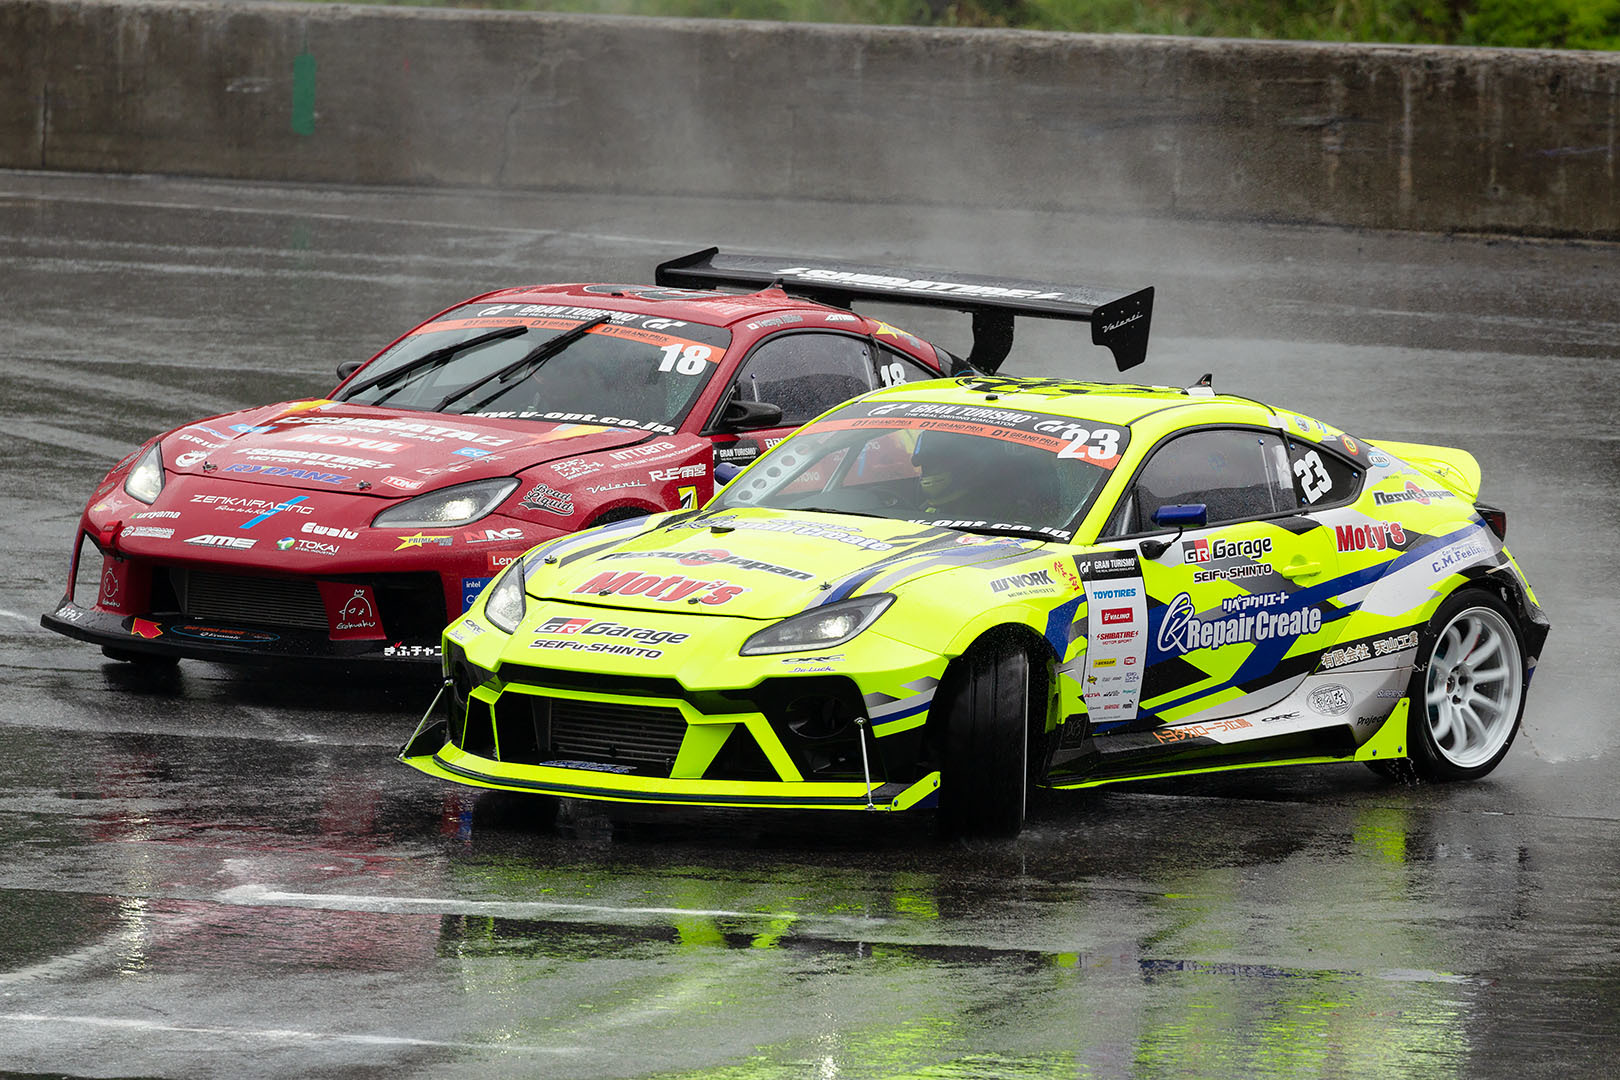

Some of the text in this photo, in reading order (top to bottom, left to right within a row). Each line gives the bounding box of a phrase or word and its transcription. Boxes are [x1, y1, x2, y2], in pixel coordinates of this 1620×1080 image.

[520, 304, 637, 322] GRAN TURISMO
[530, 319, 548, 327] D1
[1102, 312, 1143, 333] Valenti
[601, 326, 670, 342] D1 GRAND PRIX
[657, 343, 712, 376] 18
[880, 362, 907, 388] 18
[910, 404, 1031, 424] GRAN TURISMO
[940, 414, 970, 422] DRIVING
[972, 417, 1015, 427] SIMULATOR
[937, 422, 958, 430] GRAND
[287, 432, 403, 453] MOTUL
[389, 430, 444, 443] TEAM
[991, 429, 1060, 446] D1 GRAND PRIX
[1056, 428, 1121, 460] 23
[608, 447, 639, 462] NTT
[719, 447, 757, 457] GRAN TURISMO
[246, 456, 359, 472] MOTOR SPORT
[223, 463, 352, 485] RYDANZ
[1293, 450, 1333, 504] 23
[534, 484, 573, 501] Bead
[586, 480, 647, 494] Valenti
[190, 494, 314, 515] ZENKAIRACING
[527, 492, 575, 514] Liquid
[301, 522, 359, 540] Ewalu
[463, 528, 524, 542] NAC
[1335, 521, 1406, 552] Moty's
[184, 534, 259, 549] AME
[298, 540, 341, 554] TOKAI
[1181, 538, 1272, 563] GR Garage
[1094, 557, 1136, 570] GRAN TURISMO
[1006, 569, 1056, 588] WORK
[574, 570, 745, 606] Moty's
[1093, 588, 1137, 600] TOYO TIRES
[1222, 592, 1290, 612] リペアクリエート
[534, 618, 690, 645] GR Garage
[1100, 630, 1135, 640] SHIBATIRE
[1186, 607, 1322, 650] RepairCreate
[1321, 631, 1419, 669] 有限会社 天山工業
[1152, 718, 1254, 745] トヨタカローラ広島
